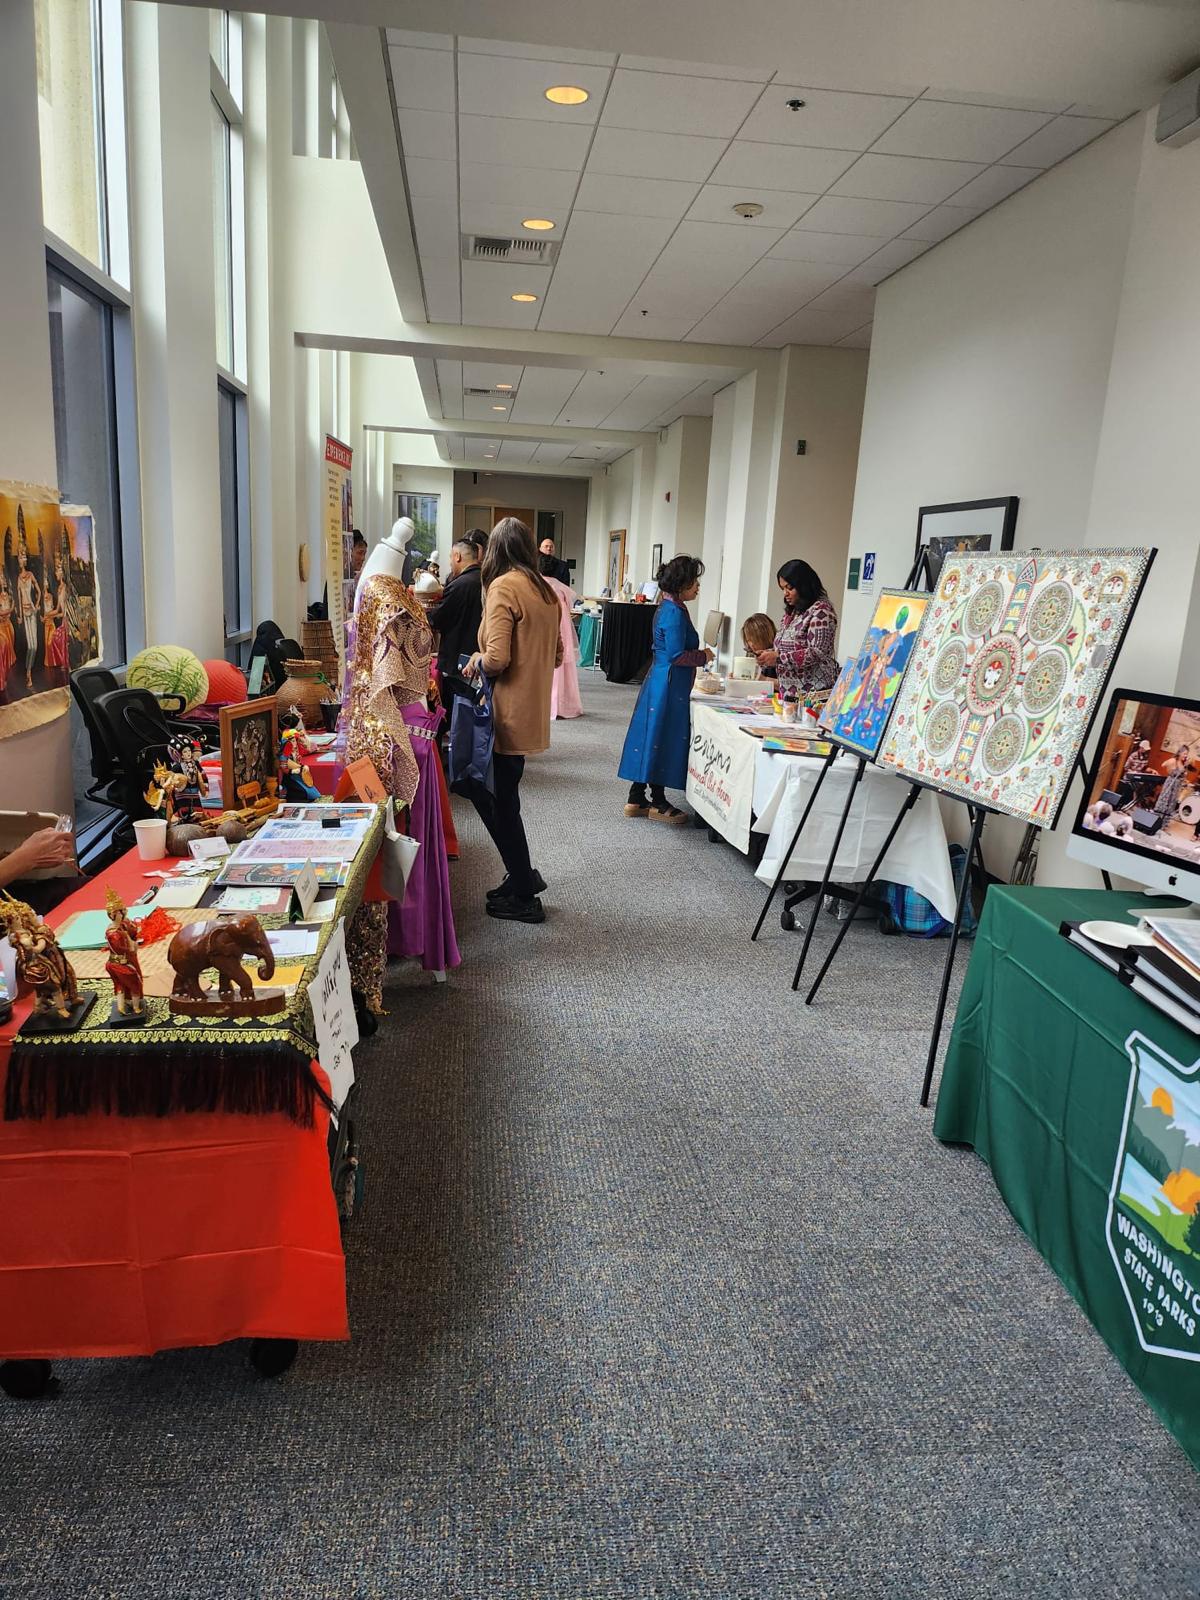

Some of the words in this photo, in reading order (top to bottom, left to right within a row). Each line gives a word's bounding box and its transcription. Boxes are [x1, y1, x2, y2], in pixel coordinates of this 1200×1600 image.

[1124, 1247, 1154, 1292] STATE
[1157, 1284, 1196, 1337] PARKS
[1143, 1298, 1164, 1327] 1913
